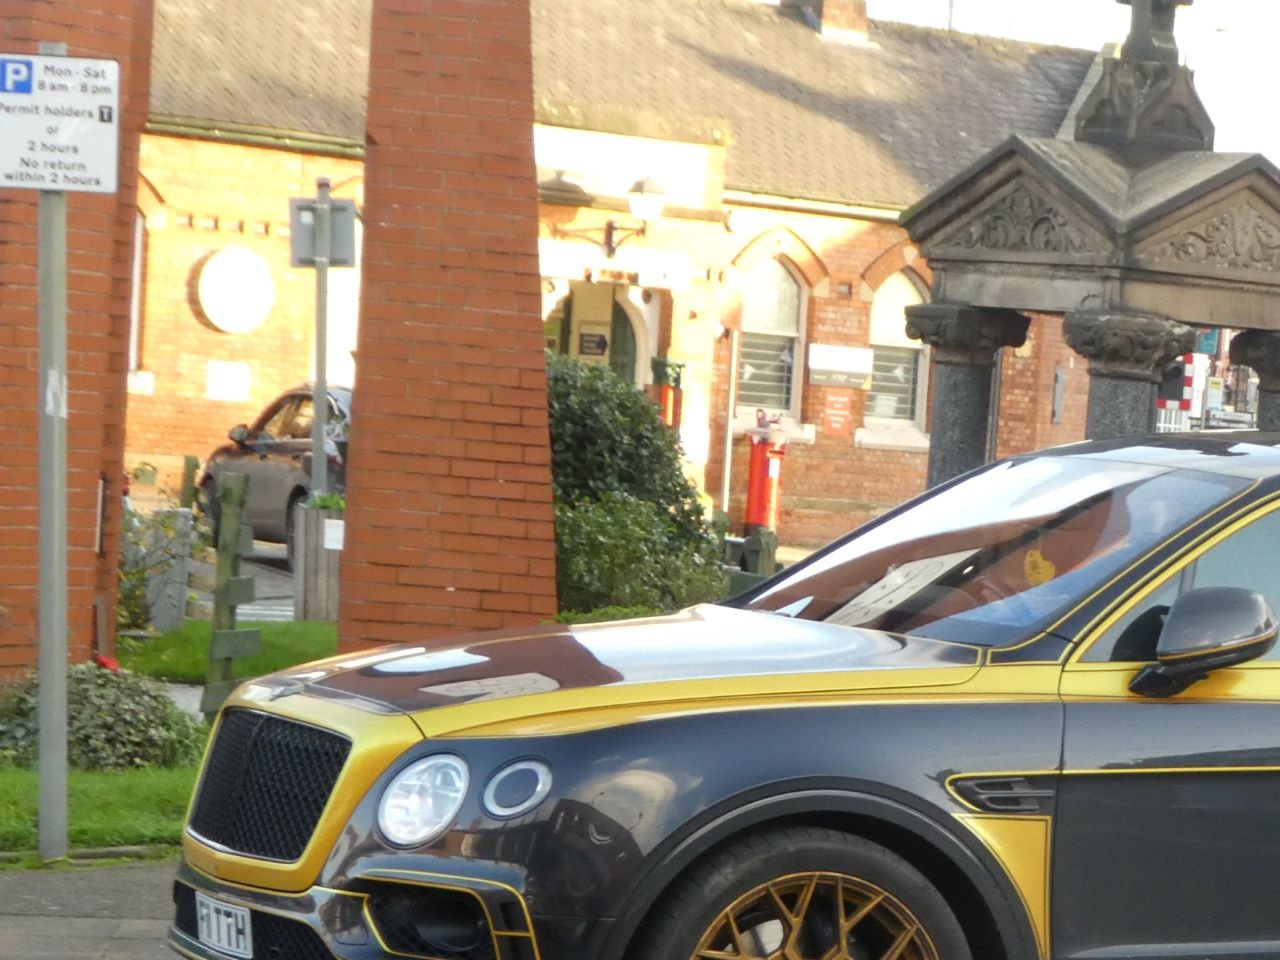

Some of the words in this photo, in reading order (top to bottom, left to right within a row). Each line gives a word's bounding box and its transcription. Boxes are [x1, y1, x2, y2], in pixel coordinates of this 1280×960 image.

[5, 63, 28, 91] P
[44, 65, 72, 76] Mon
[83, 66, 106, 79] Sat
[38, 80, 46, 91] 8
[49, 83, 69, 92] am
[80, 82, 88, 93] 8
[91, 85, 111, 95] pm
[45, 105, 94, 118] holders
[46, 126, 60, 135] or
[28, 140, 36, 152] 2
[41, 142, 78, 154] hours
[20, 157, 39, 168] No
[44, 161, 86, 172] return
[4, 171, 46, 182] within
[50, 172, 58, 184] 2
[63, 174, 101, 186] hours
